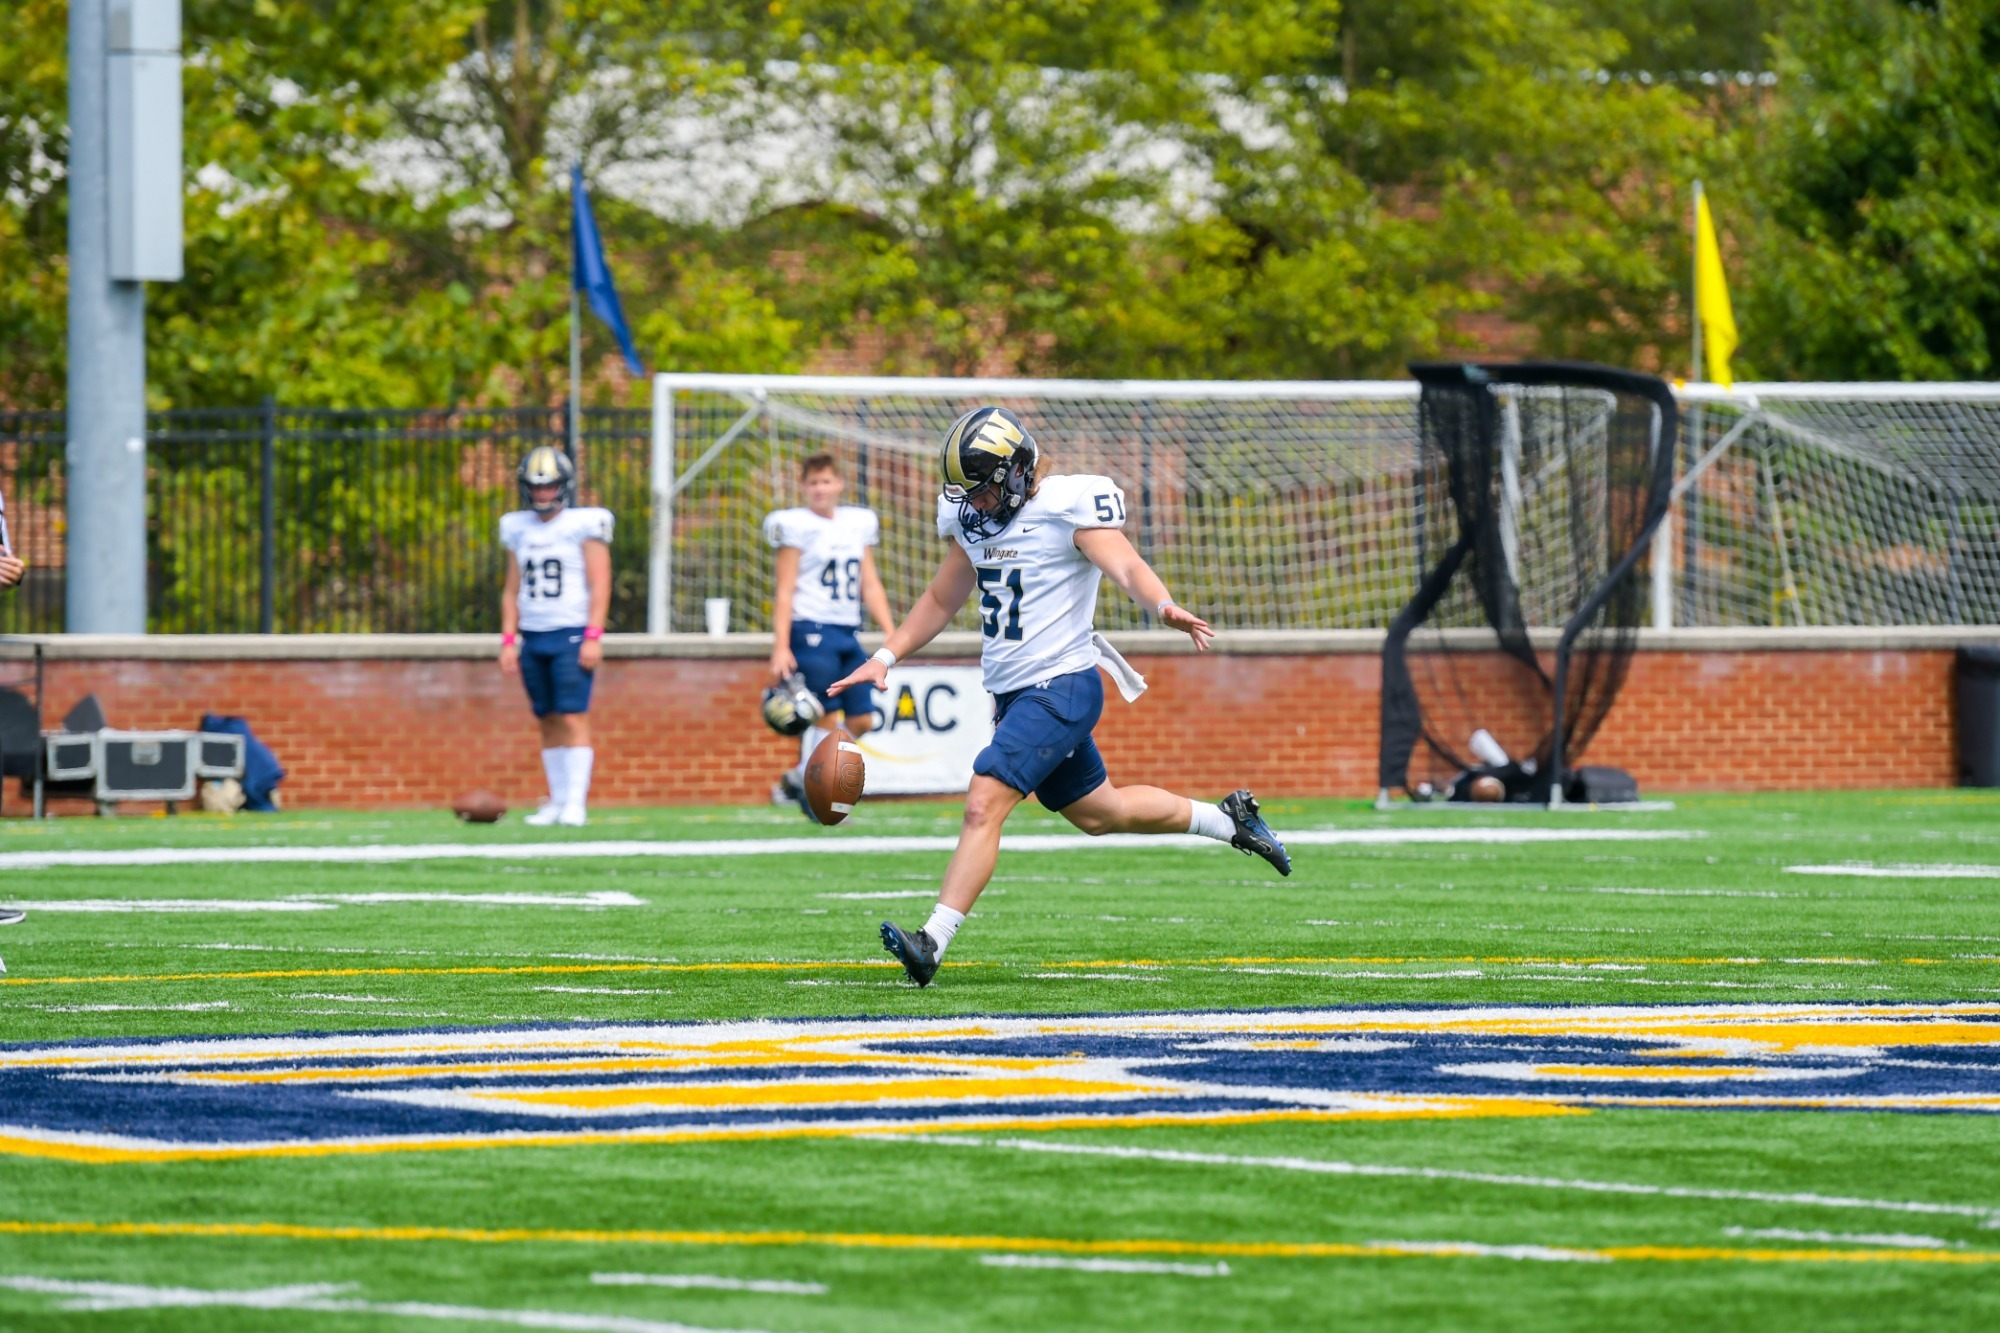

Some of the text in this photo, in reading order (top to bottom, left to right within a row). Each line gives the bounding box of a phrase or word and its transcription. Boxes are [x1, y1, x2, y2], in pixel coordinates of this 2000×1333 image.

[1094, 493, 1125, 522] 51
[983, 547, 1019, 560] Wingate
[820, 558, 863, 601] 48
[976, 565, 1024, 642] 51
